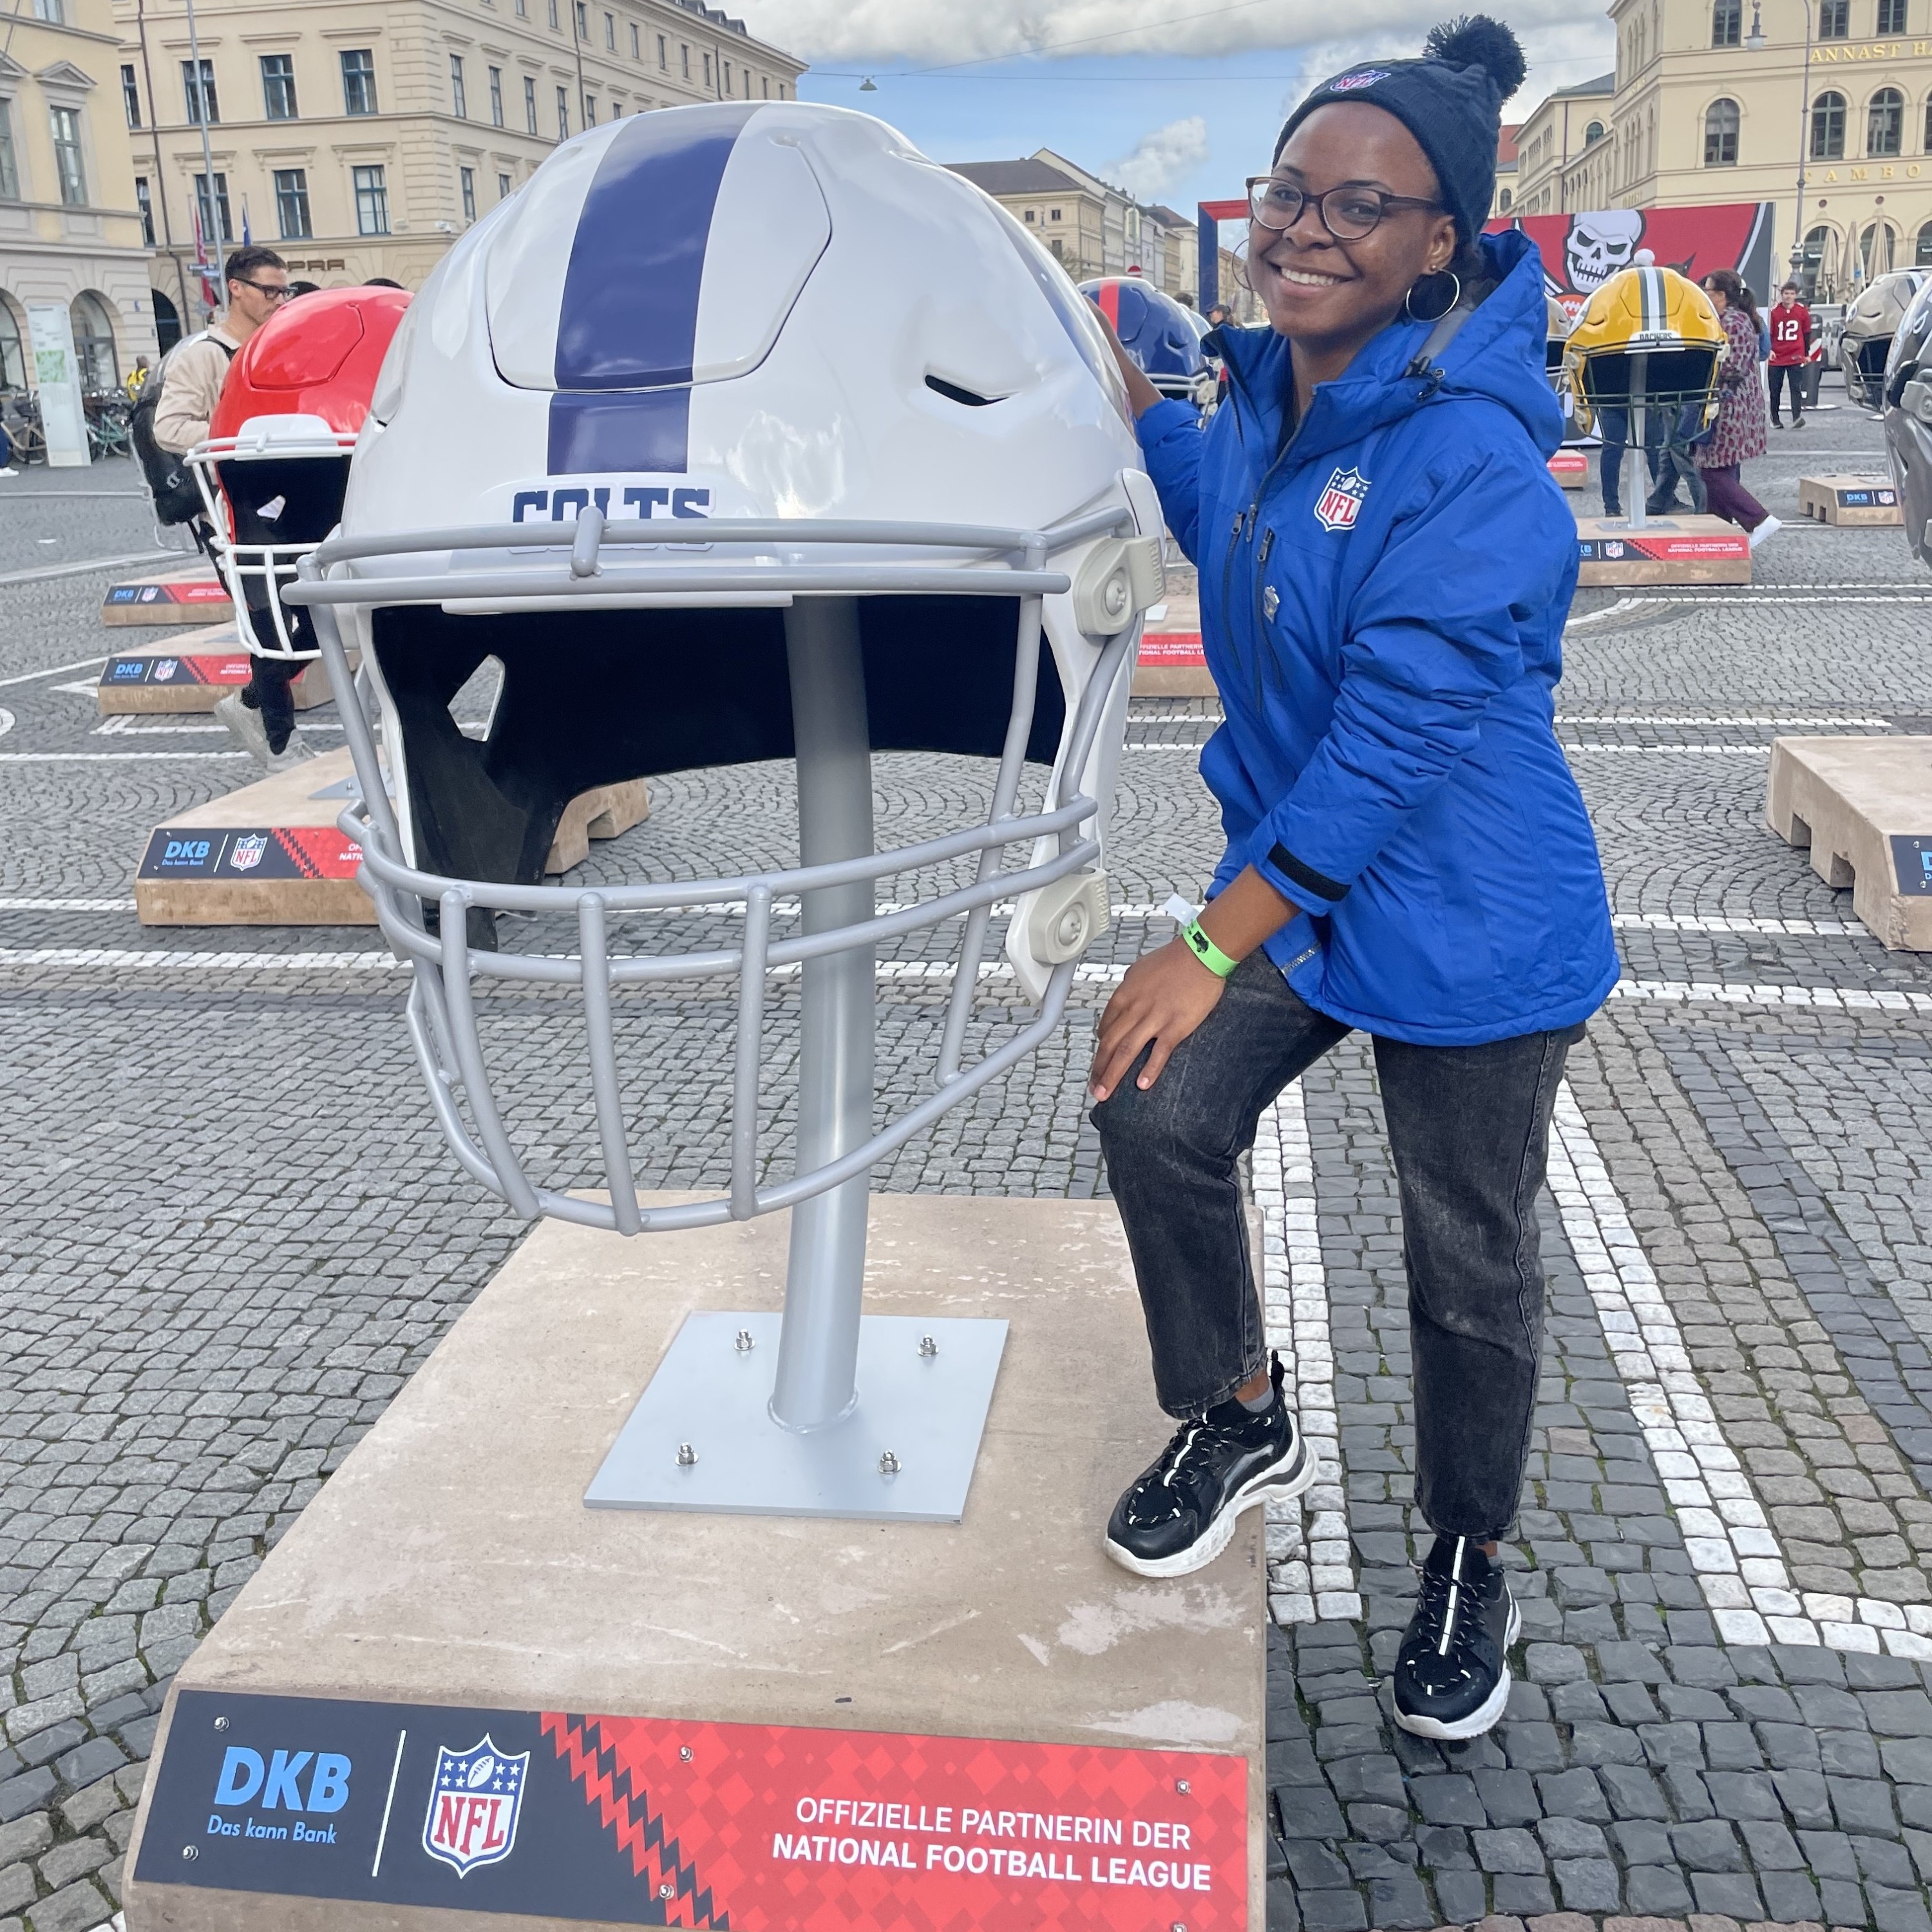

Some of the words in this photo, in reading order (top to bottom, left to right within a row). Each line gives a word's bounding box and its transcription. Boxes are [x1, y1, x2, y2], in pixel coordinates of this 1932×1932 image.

[1810, 43, 1900, 63] ANNAST
[1913, 42, 1932, 57] H
[1336, 77, 1368, 88] NFL
[1777, 319, 1799, 341] 12
[1321, 490, 1355, 522] NFL
[115, 589, 135, 598] DKB
[115, 663, 143, 675] DKB
[164, 840, 211, 858] DKB
[235, 850, 257, 865] NFL
[214, 1746, 352, 1813] DKB
[207, 1814, 240, 1836] Das
[245, 1817, 287, 1840] kann
[292, 1821, 337, 1844] Bank
[433, 1795, 504, 1856] NFL
[796, 1797, 953, 1833] OFFIZIELLE
[961, 1808, 1122, 1846] PARTNERIN
[1132, 1821, 1191, 1851] DER
[772, 1833, 918, 1868] NATIONAL
[925, 1844, 1082, 1882] FOOTBALL
[1091, 1856, 1211, 1891] LEAGUE
